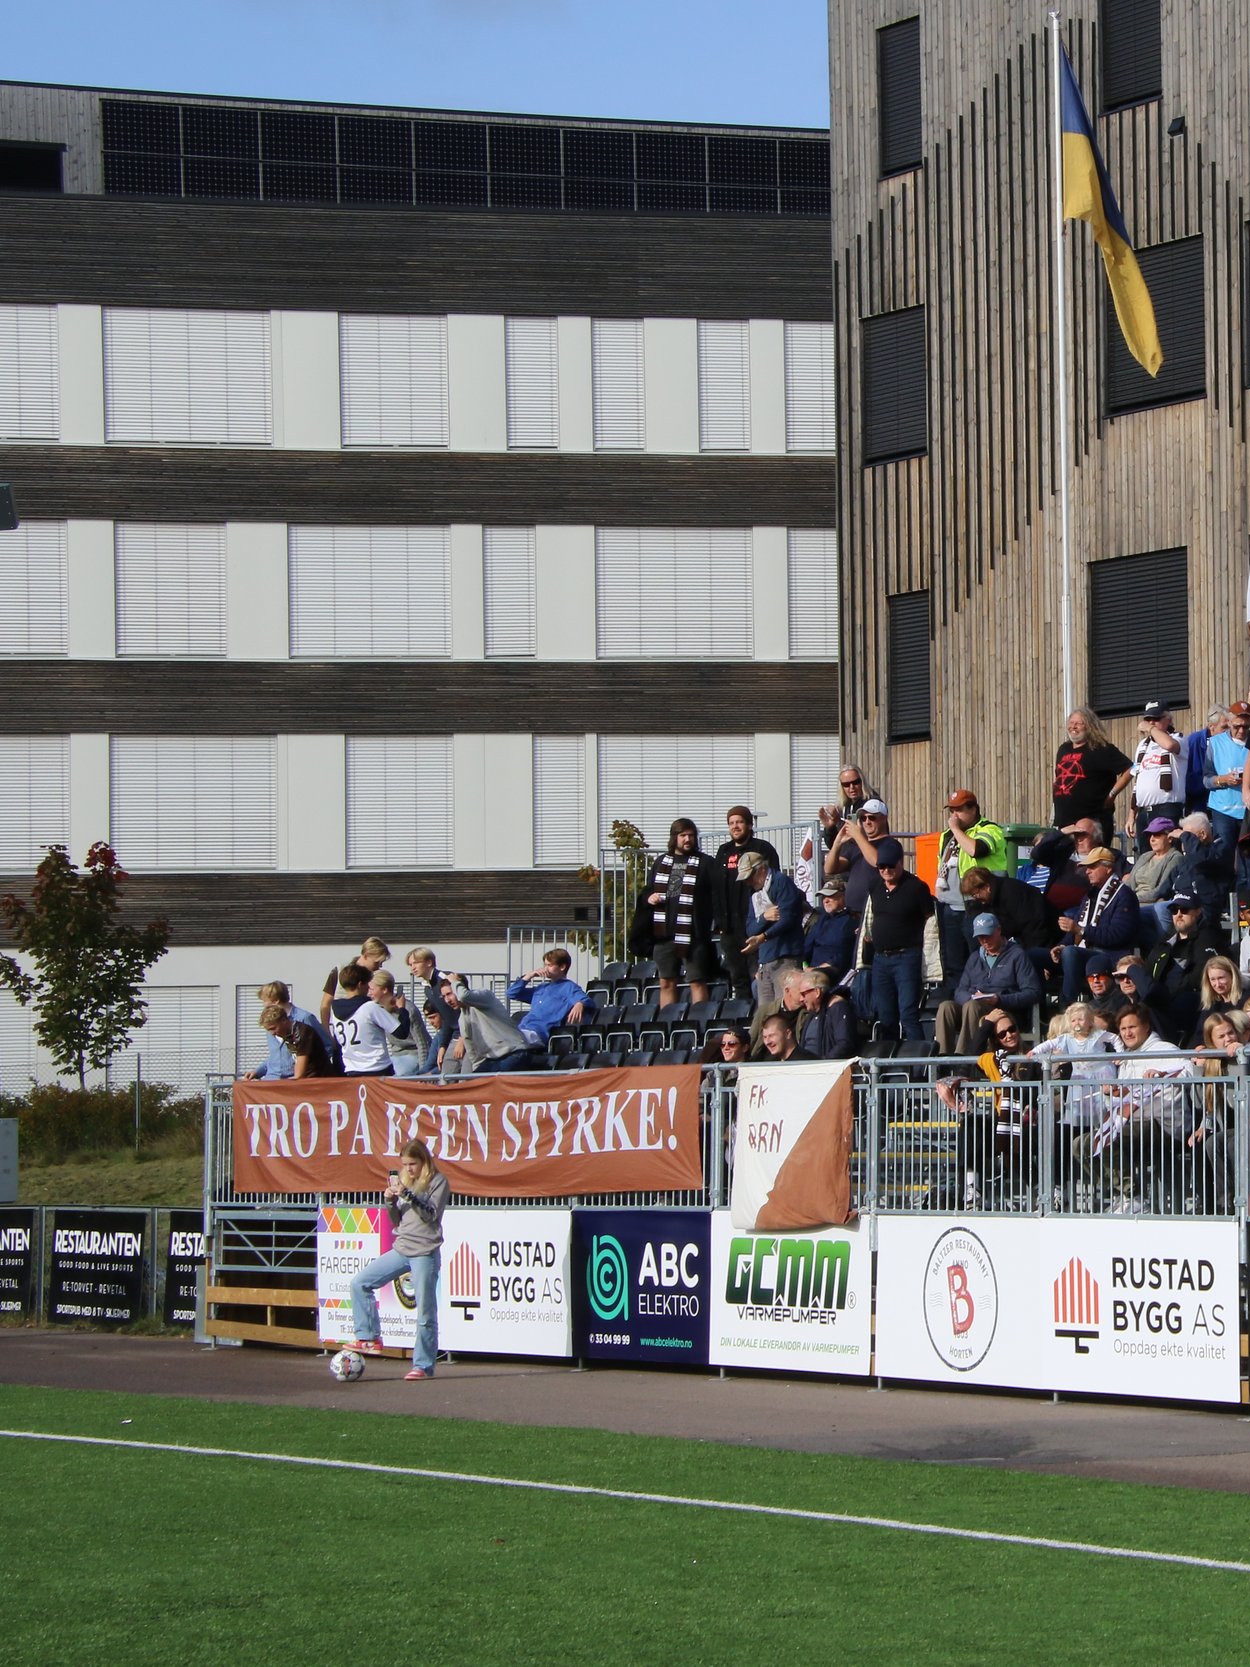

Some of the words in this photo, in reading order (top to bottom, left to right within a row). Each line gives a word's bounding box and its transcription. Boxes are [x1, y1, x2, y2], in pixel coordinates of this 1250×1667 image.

[244, 1102, 319, 1159] TRO
[328, 1084, 374, 1156] PÅ
[385, 1101, 492, 1163] EGEN
[500, 1086, 679, 1163] STYRKE!
[54, 1228, 142, 1257] RESTAURANTEN
[58, 1260, 73, 1269] GOOD
[75, 1262, 89, 1270] FOOD
[97, 1263, 109, 1271] LIVE
[320, 1257, 377, 1274] FARGERIK
[489, 1240, 556, 1269] RUSTAD
[638, 1242, 700, 1288] ABC
[932, 1241, 954, 1276] BALTZER
[955, 1239, 989, 1279] RESTAURANT
[1111, 1257, 1215, 1291] RUSTAD
[98, 1283, 127, 1296] REVETAL
[490, 1275, 535, 1303] BYGG
[541, 1278, 563, 1304] AS
[489, 1307, 518, 1324] Oppdag
[520, 1310, 536, 1321] ekte
[537, 1309, 563, 1323] kvalitet
[638, 1292, 700, 1318] ELEKTRO
[737, 1305, 837, 1325] VARMEPUMPER
[1112, 1300, 1183, 1334] BYGG
[1192, 1304, 1226, 1337] AS
[640, 1336, 693, 1349] www.abcelektro.no
[720, 1337, 732, 1346] DIN
[733, 1337, 758, 1348] LOKALE
[802, 1342, 811, 1352] AV
[811, 1343, 860, 1355] VARMEPUMPER
[949, 1346, 973, 1359] HORTEN
[1113, 1339, 1157, 1358] Oppdag
[1160, 1340, 1184, 1357] ekte
[1186, 1342, 1226, 1360] kvalitet
